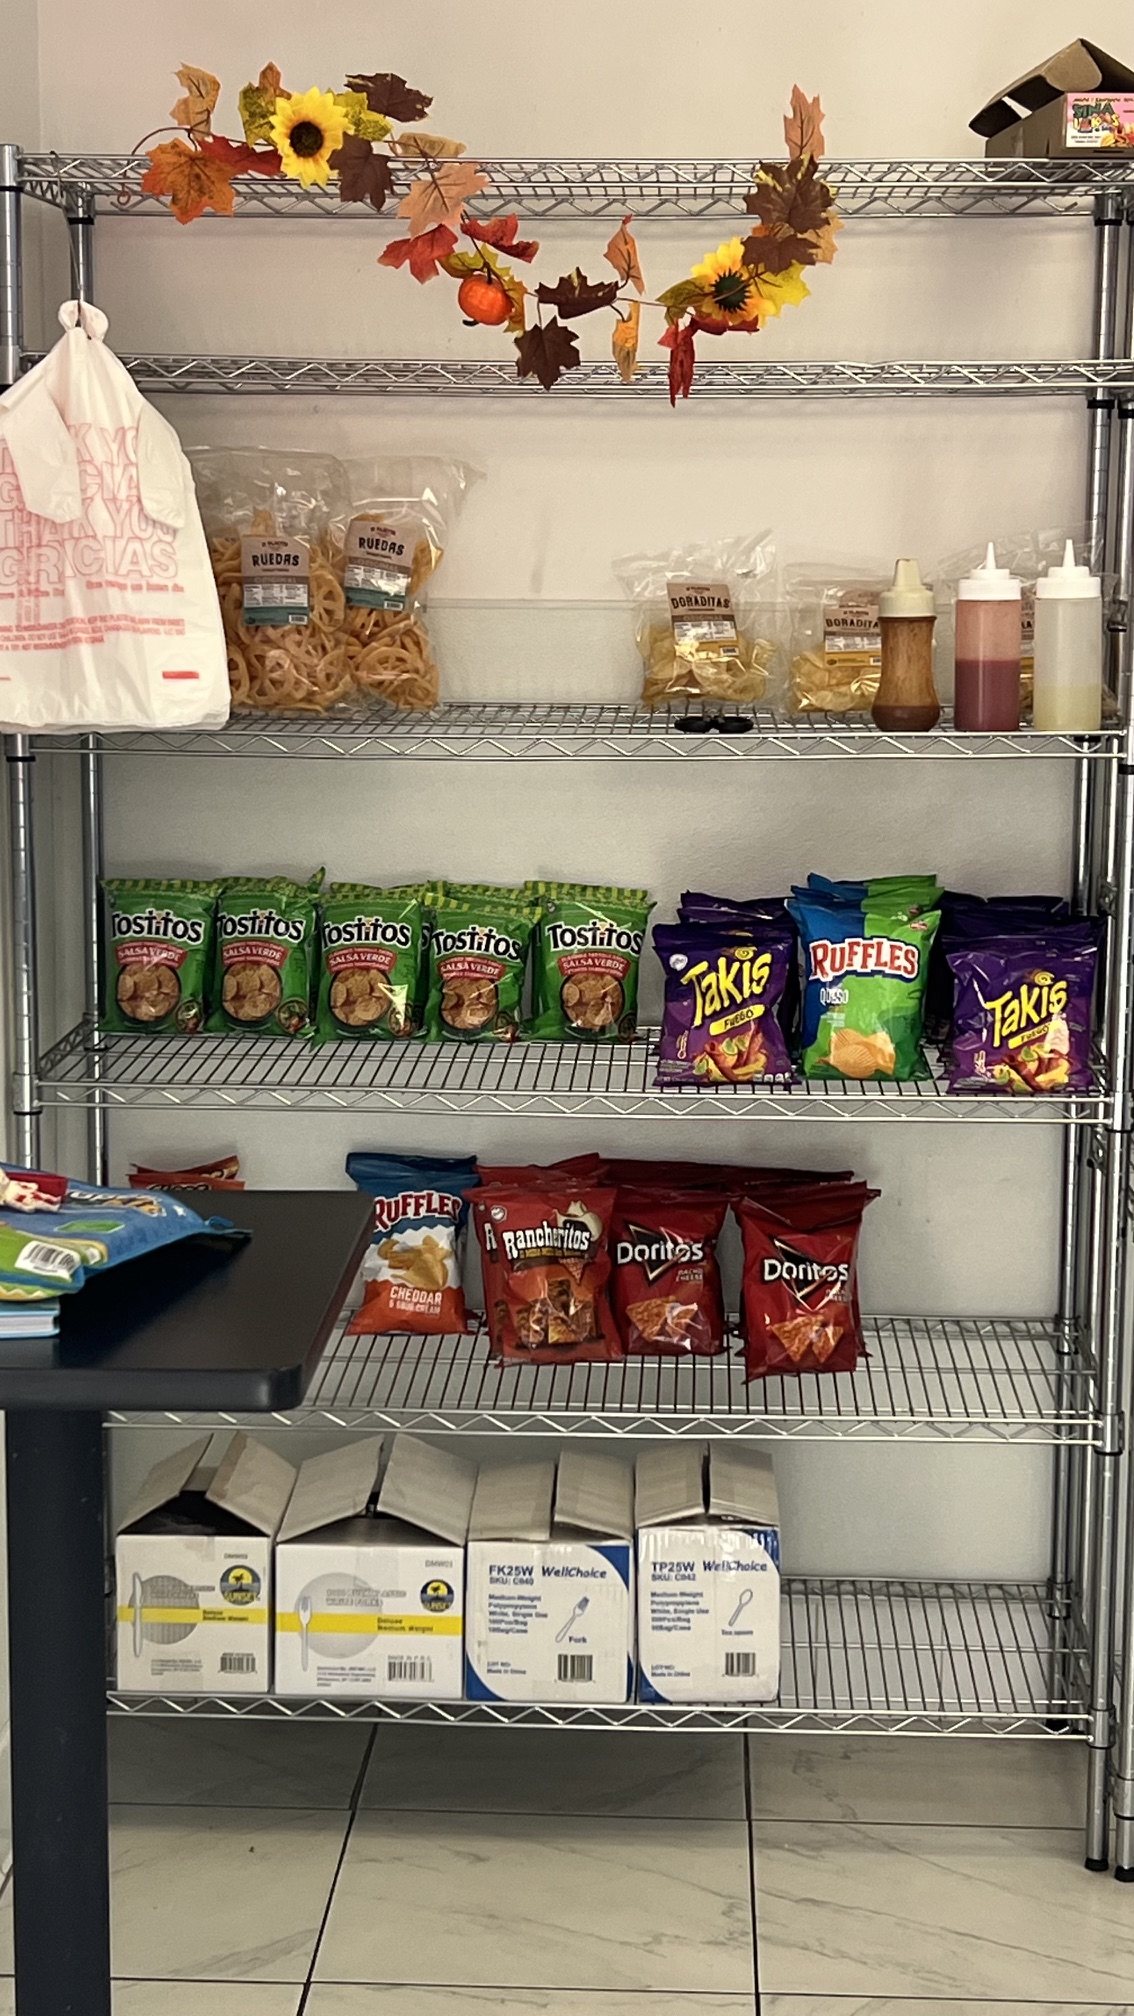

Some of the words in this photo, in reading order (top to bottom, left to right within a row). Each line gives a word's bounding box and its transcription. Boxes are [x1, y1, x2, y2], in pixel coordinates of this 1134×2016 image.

[359, 536, 405, 556] RUEDAS
[252, 553, 300, 567] RUEDAS
[671, 596, 730, 609] DORADITAS
[825, 618, 879, 629] DORADITA
[223, 947, 250, 958] SALSA
[252, 948, 282, 960] VERDE
[329, 953, 359, 965] SALSA
[361, 953, 391, 965] VERDE
[811, 938, 919, 978] RUFFLES
[440, 962, 468, 972] SALSA
[470, 964, 500, 976] VERDE
[563, 959, 593, 969] SALSA
[594, 959, 626, 971] VERDE
[681, 948, 772, 1027] Takis
[820, 987, 849, 1006] QUESO
[986, 972, 1068, 1048] Takis
[723, 1009, 754, 1031] FUEGO
[502, 1220, 591, 1260] Rancheritos
[616, 1240, 704, 1265] Doritos
[763, 1259, 849, 1282] Doritos
[390, 1286, 442, 1306] CHEDDAR
[489, 1565, 534, 1576] FK25W
[542, 1565, 607, 1579] WellChoice
[652, 1561, 695, 1573] TP25W
[703, 1560, 768, 1572] WellChoice
